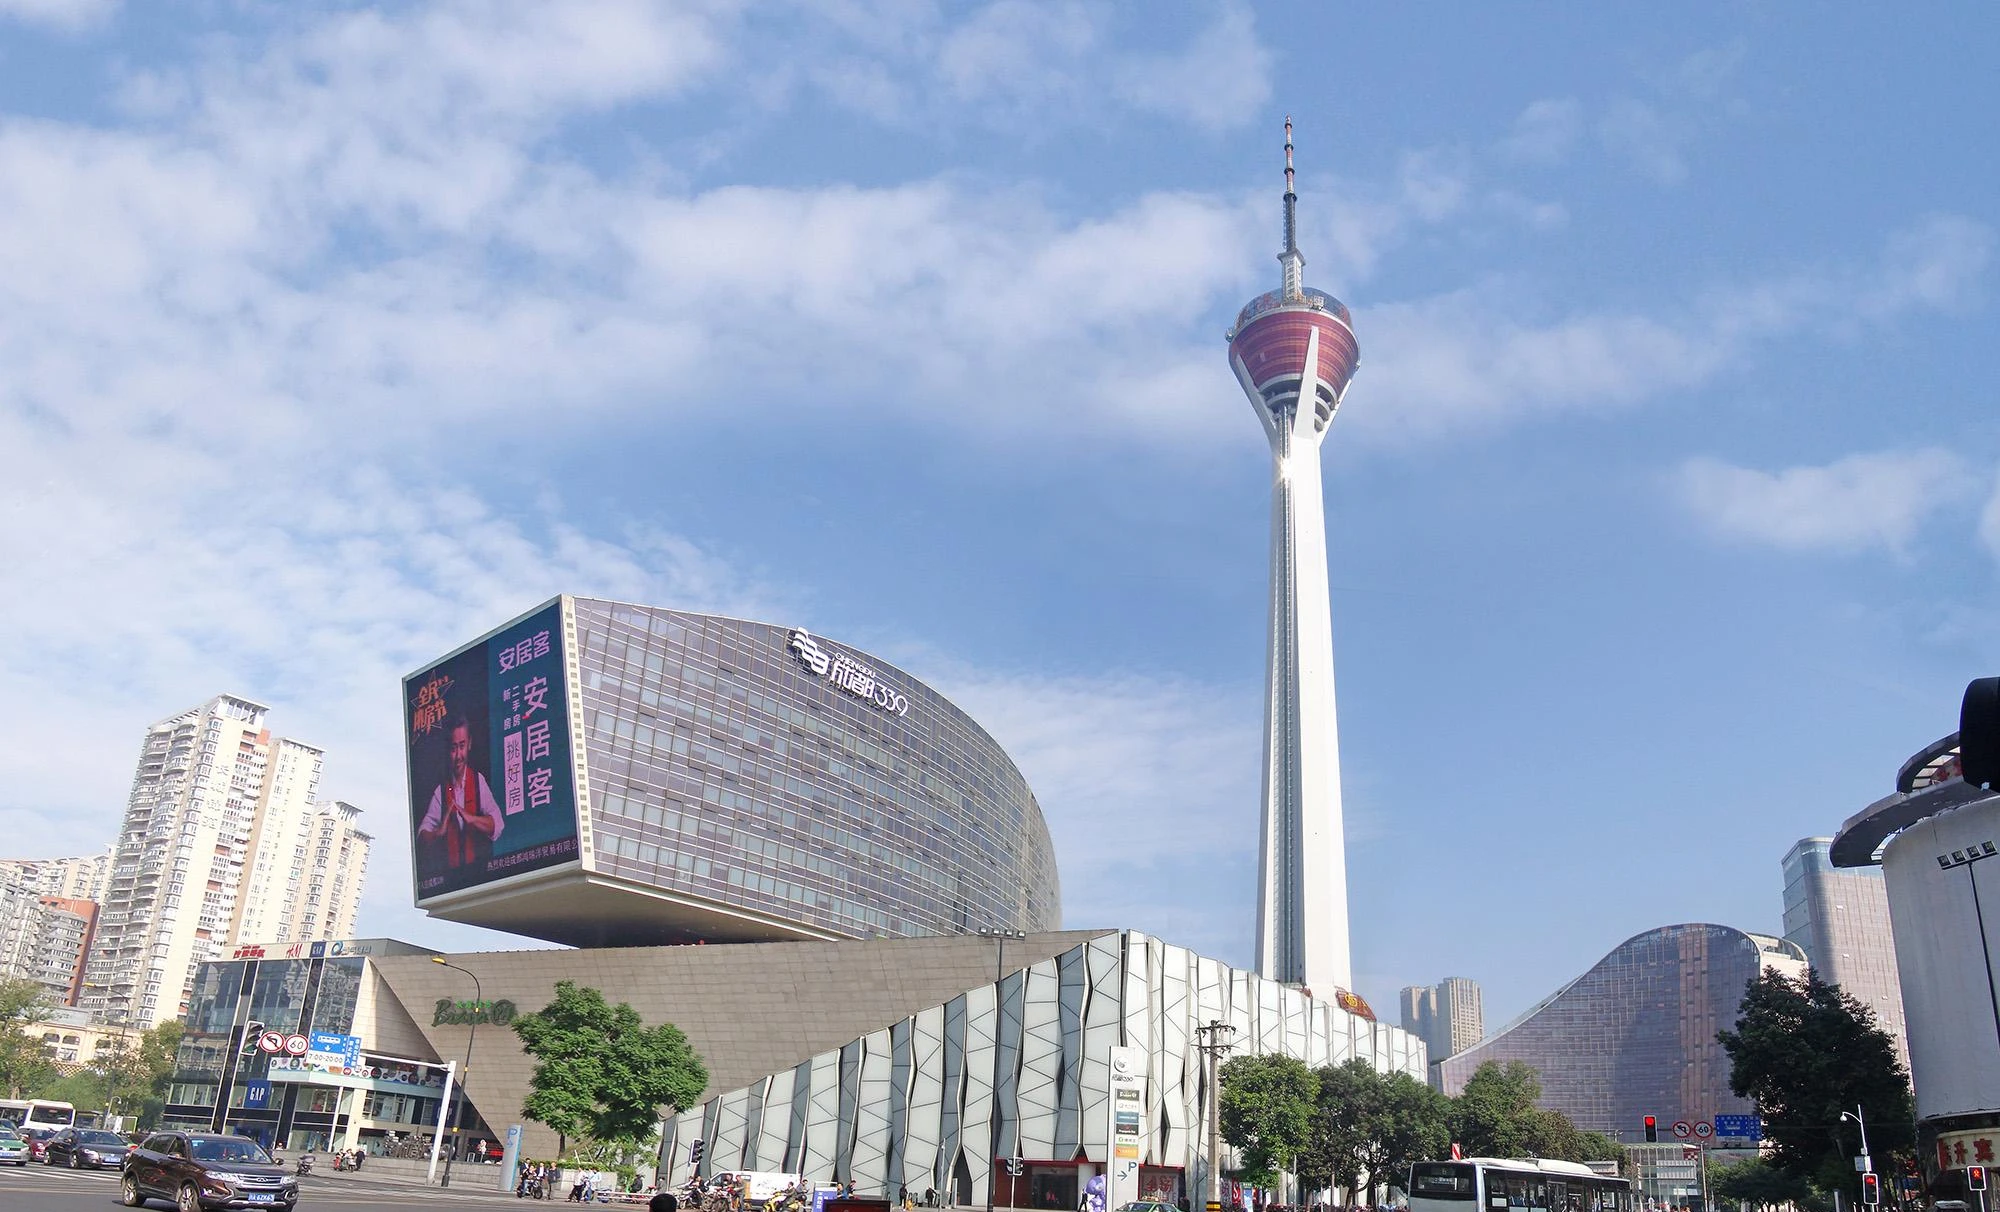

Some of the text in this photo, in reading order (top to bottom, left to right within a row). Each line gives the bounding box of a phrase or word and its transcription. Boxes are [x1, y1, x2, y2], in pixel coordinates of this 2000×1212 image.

[499, 630, 550, 674] 安居客
[835, 652, 876, 678] CHENGDU
[512, 685, 521, 727] 二手房
[523, 676, 553, 809] 安居客
[507, 739, 521, 808] 挑好房
[290, 1041, 303, 1049] 60
[250, 1087, 265, 1100] GAP
[1128, 1161, 1137, 1172] P
